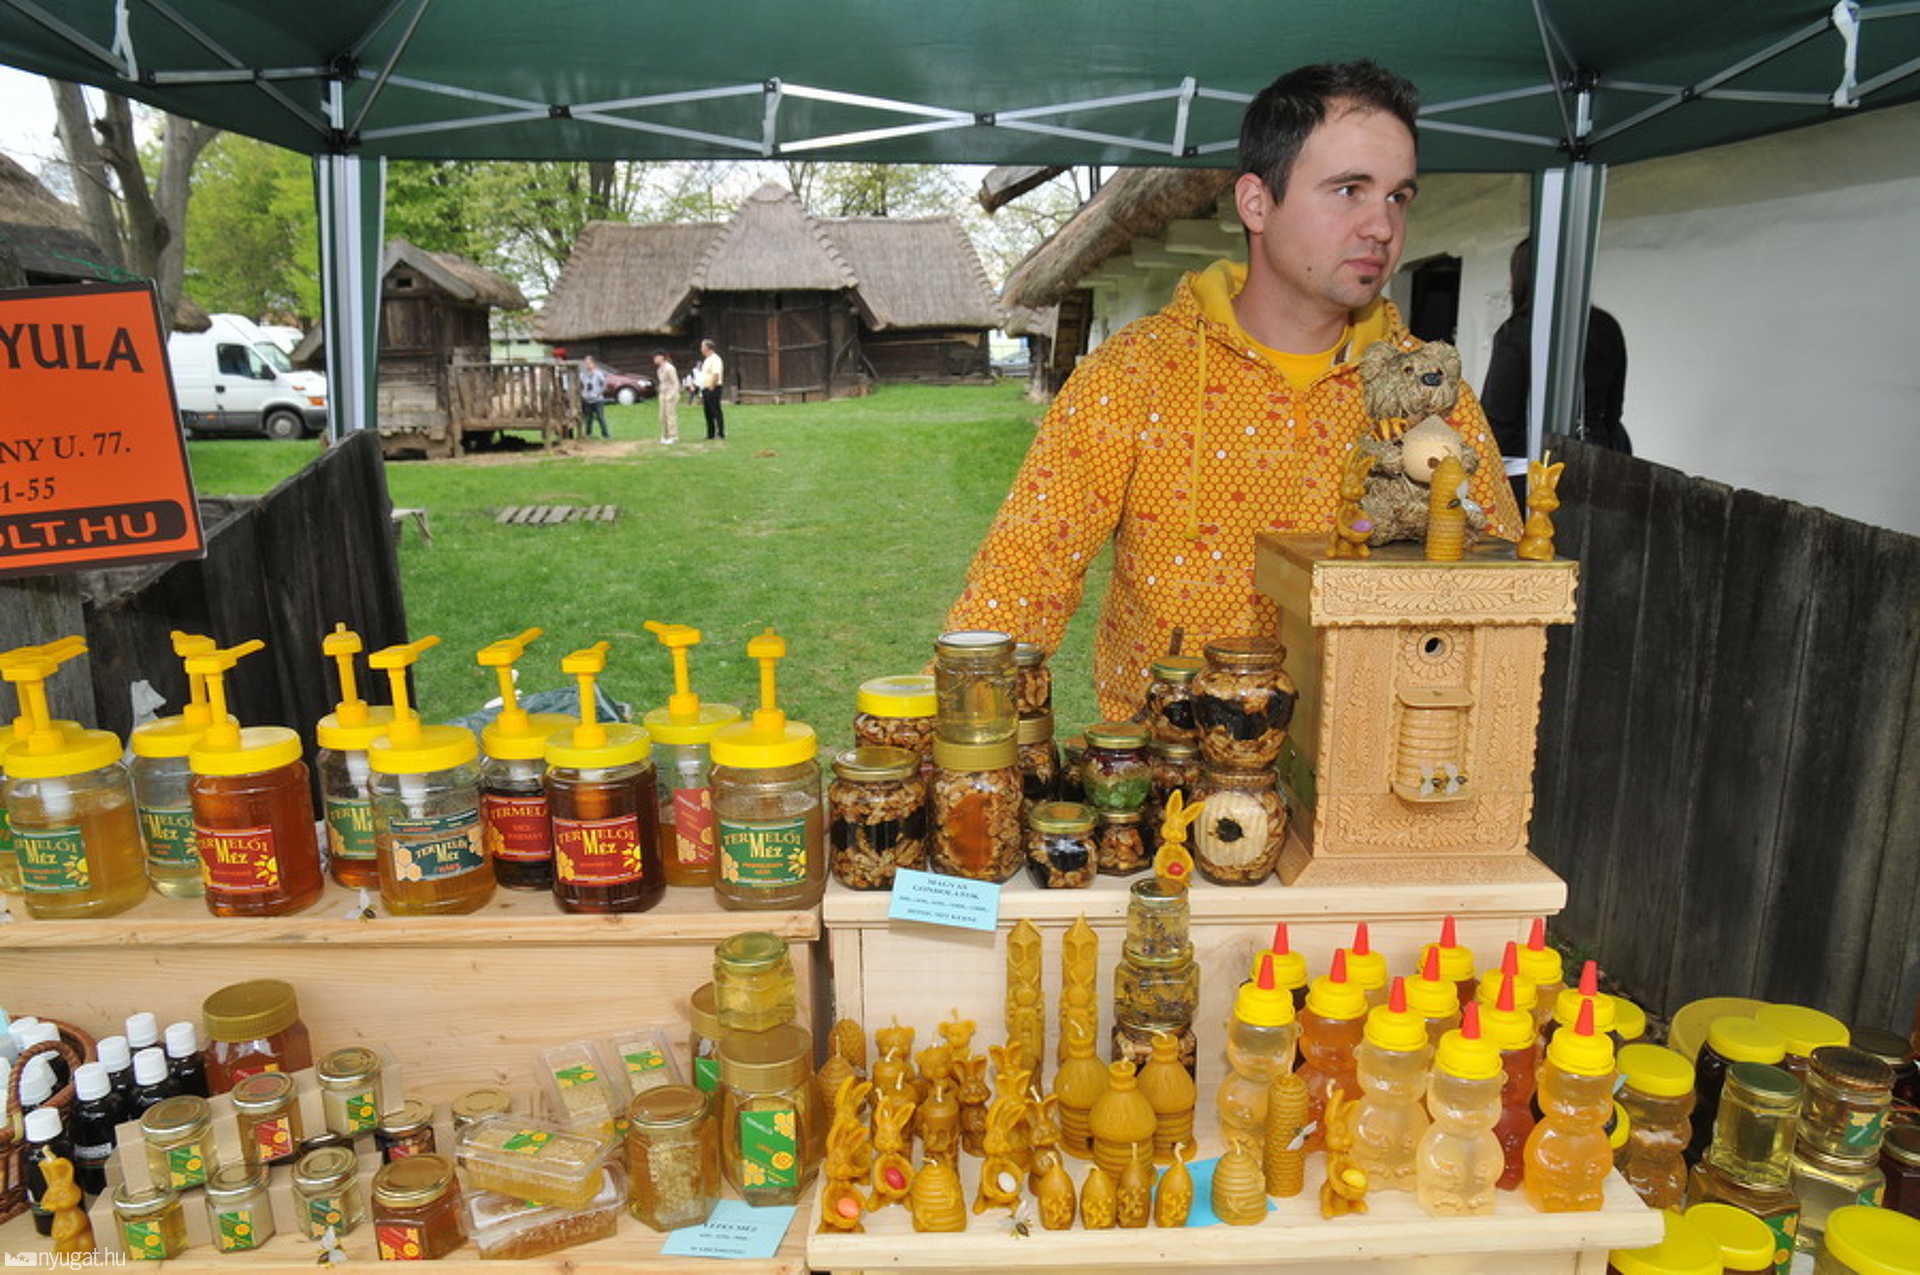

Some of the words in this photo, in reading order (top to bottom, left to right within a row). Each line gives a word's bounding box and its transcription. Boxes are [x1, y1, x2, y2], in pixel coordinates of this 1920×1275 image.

[0, 323, 145, 374] YULA
[53, 435, 84, 459] U.
[93, 431, 131, 456] 77.
[0, 477, 56, 503] 1-55
